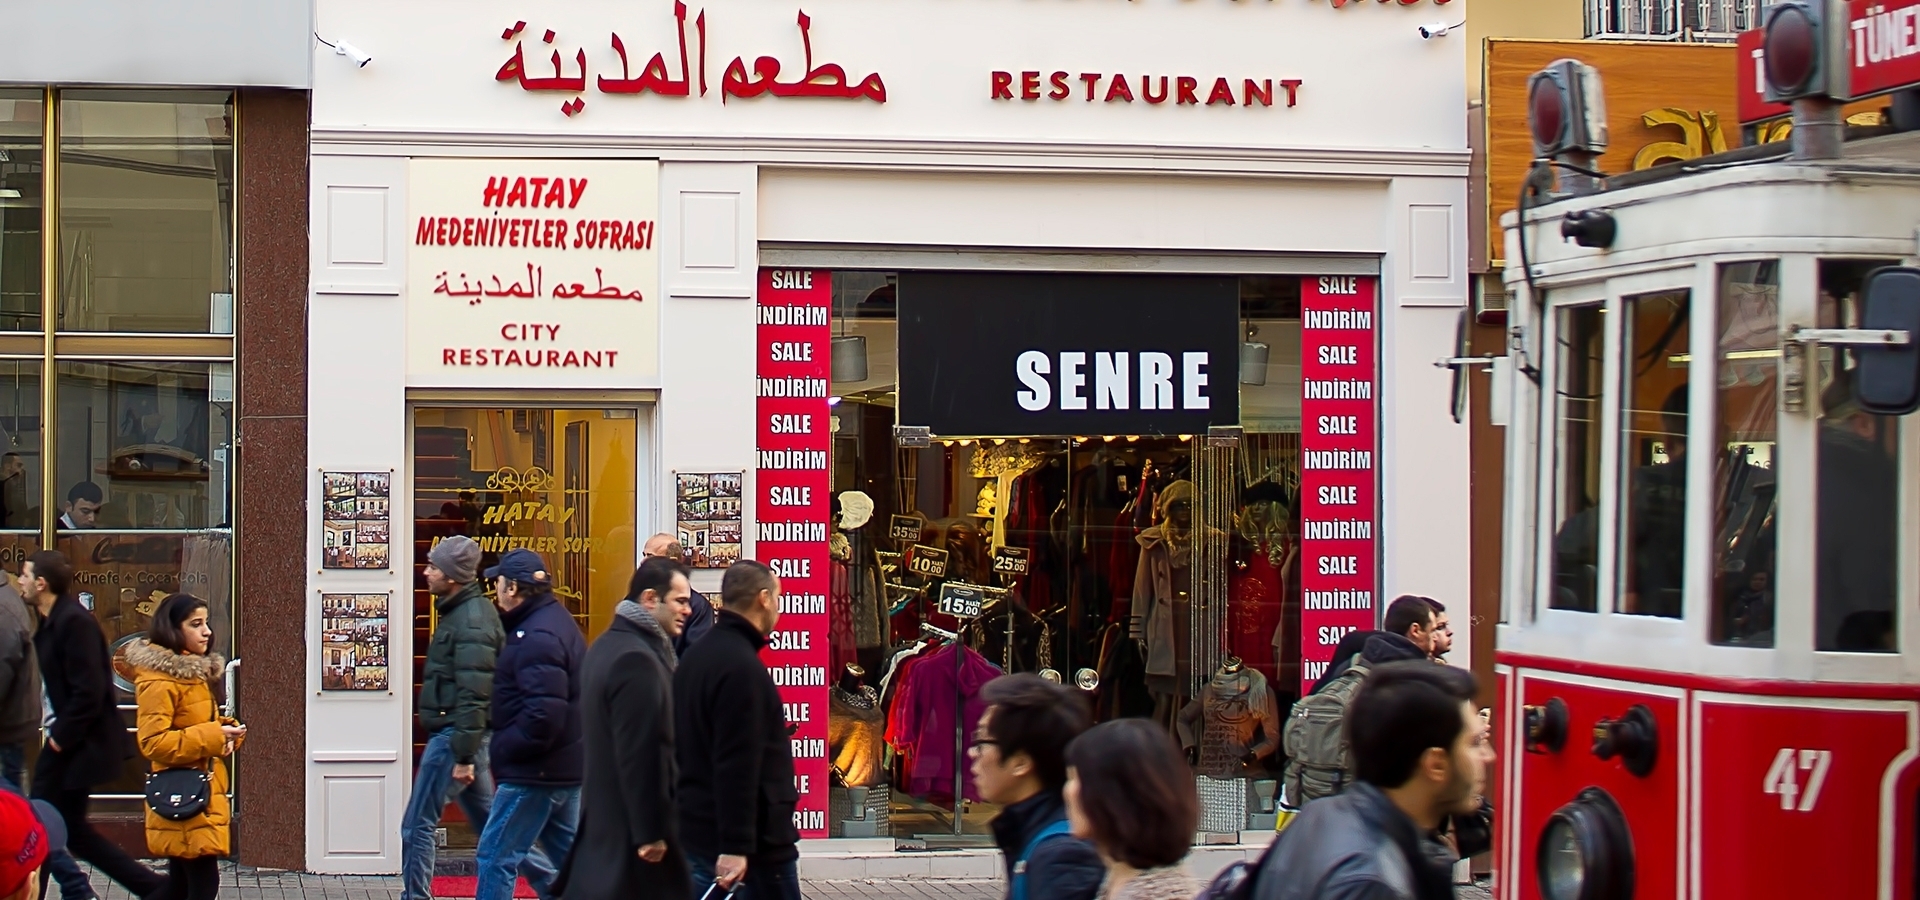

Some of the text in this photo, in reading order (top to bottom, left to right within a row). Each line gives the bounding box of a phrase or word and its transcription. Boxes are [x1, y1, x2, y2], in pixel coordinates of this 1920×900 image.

[495, 0, 887, 117] مطعم المدينة
[991, 70, 1302, 107] RESTAURANT
[483, 176, 588, 209] HATAY
[416, 211, 654, 251] MEDENİYETLER SOFRASI
[434, 262, 643, 306] مطعم المدينة
[772, 270, 812, 290] SALE
[1318, 276, 1357, 294] SALE
[757, 303, 827, 326] İNDİRİM
[1304, 307, 1371, 330] İNDİRİM
[501, 324, 560, 341] CITY
[443, 349, 618, 367] RESTAURANT
[771, 342, 812, 362] SALE
[1318, 345, 1357, 365] SALE
[757, 375, 827, 398] İNDİRİM
[1017, 351, 1210, 411] SENRE
[1304, 377, 1371, 399] İNDİRİM
[771, 414, 811, 434] SALE
[1318, 415, 1357, 435] SALE
[756, 447, 826, 470] İNDİRİM
[1304, 447, 1371, 470] İNDİRİM
[770, 486, 811, 506] SALE
[1318, 486, 1357, 505] SALE
[483, 502, 575, 524] HATAY
[756, 519, 826, 542] İNDİRİM
[1304, 517, 1371, 540] İNDİRİM
[770, 558, 811, 578] SALE
[1318, 556, 1357, 575] SALE
[73, 570, 119, 584] Künefe
[136, 571, 208, 584] Coca-Cola
[777, 591, 826, 614] DİRİM
[1304, 587, 1371, 610] İNDİRİM
[769, 630, 810, 650] SALE
[767, 663, 825, 686] DİRİM
[783, 703, 810, 722] ALE
[1763, 747, 1832, 812] 47
